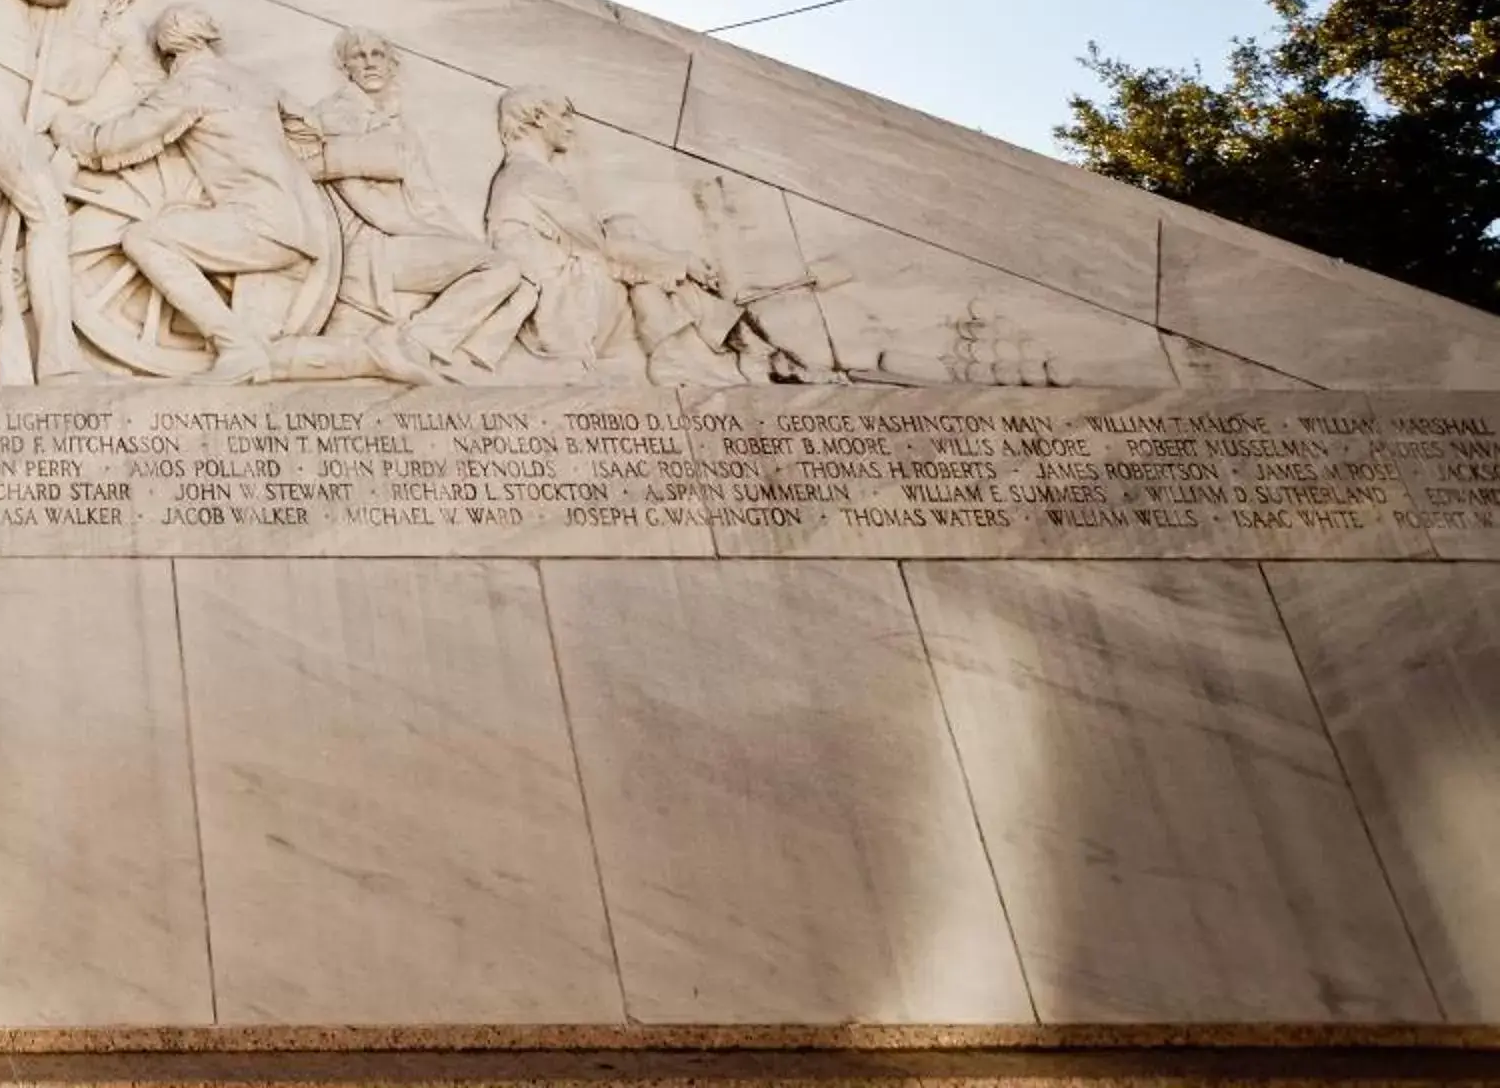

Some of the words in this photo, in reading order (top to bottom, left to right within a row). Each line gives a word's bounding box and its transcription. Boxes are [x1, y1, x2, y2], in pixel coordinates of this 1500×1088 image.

[7, 412, 112, 431] LIGHTFOOT
[151, 413, 257, 432] JONATHAN
[287, 413, 363, 432] LINDLEY
[396, 413, 472, 432] WILLIAM
[482, 413, 529, 432] LINN
[564, 414, 639, 433] TORIBIO
[669, 414, 743, 433] LOSOYA
[778, 414, 854, 433] GEORGE
[859, 415, 997, 433] WASHINGTON
[1002, 415, 1052, 434] MAIN
[1085, 416, 1165, 434] WILLIAM
[1189, 416, 1270, 435] MALONE
[1298, 417, 1379, 435] WILLIAM
[52, 435, 180, 453] MITCHASSON
[228, 436, 289, 454] EDWIN
[317, 436, 413, 454] MITCHELL
[453, 437, 558, 455] NAPOLEON
[587, 437, 682, 456] MITCHELL
[724, 438, 796, 456] ROBERT
[823, 438, 892, 456] MOORE
[1021, 439, 1091, 457] MOORE
[1127, 439, 1198, 457] ROBERT
[1205, 440, 1329, 458] MUSSELMAN
[26, 460, 83, 478] PERRY
[129, 460, 185, 478] AMOS
[195, 460, 281, 478] POLLARD
[318, 460, 373, 478] JOHN
[383, 460, 446, 478] PURDY
[456, 460, 556, 478] REYNOLDS
[592, 460, 647, 479] ISAAC
[659, 460, 760, 479] ROBINSON
[800, 461, 881, 479] THOMAS
[915, 461, 997, 479] ROBERTS
[1035, 462, 1099, 480] JAMES
[1107, 462, 1220, 481] ROBERTSON
[1255, 463, 1317, 481] JAMES
[1348, 463, 1399, 481] ROSE
[70, 483, 130, 501] STARR
[174, 483, 231, 501] JOHN
[265, 483, 353, 501] STEWART
[391, 483, 477, 501] RICHARD
[504, 483, 608, 501] STOCKTON
[667, 483, 725, 502] SPAIN
[734, 483, 850, 502] SUMMERLIN
[901, 483, 984, 503] WILLIAM
[1010, 484, 1106, 503] SUMMERS
[1147, 484, 1228, 503] WILLIAM
[1255, 485, 1387, 504] SUTHERLAND
[1, 508, 38, 525] ASA
[43, 508, 122, 525] WALKER
[161, 508, 225, 525] JACOB
[232, 508, 309, 526] WALKER
[348, 508, 435, 526] MICHAEL
[465, 508, 524, 526] WARD
[563, 508, 637, 526] JOSEPH
[665, 508, 802, 527] WASHINGTON
[840, 508, 927, 527] THOMAS
[930, 508, 1010, 527] WATERS
[1045, 509, 1129, 528] WILLIAM
[1134, 509, 1199, 528] WELLS
[1232, 510, 1293, 528] ISAAC
[1299, 510, 1365, 528] WHITE
